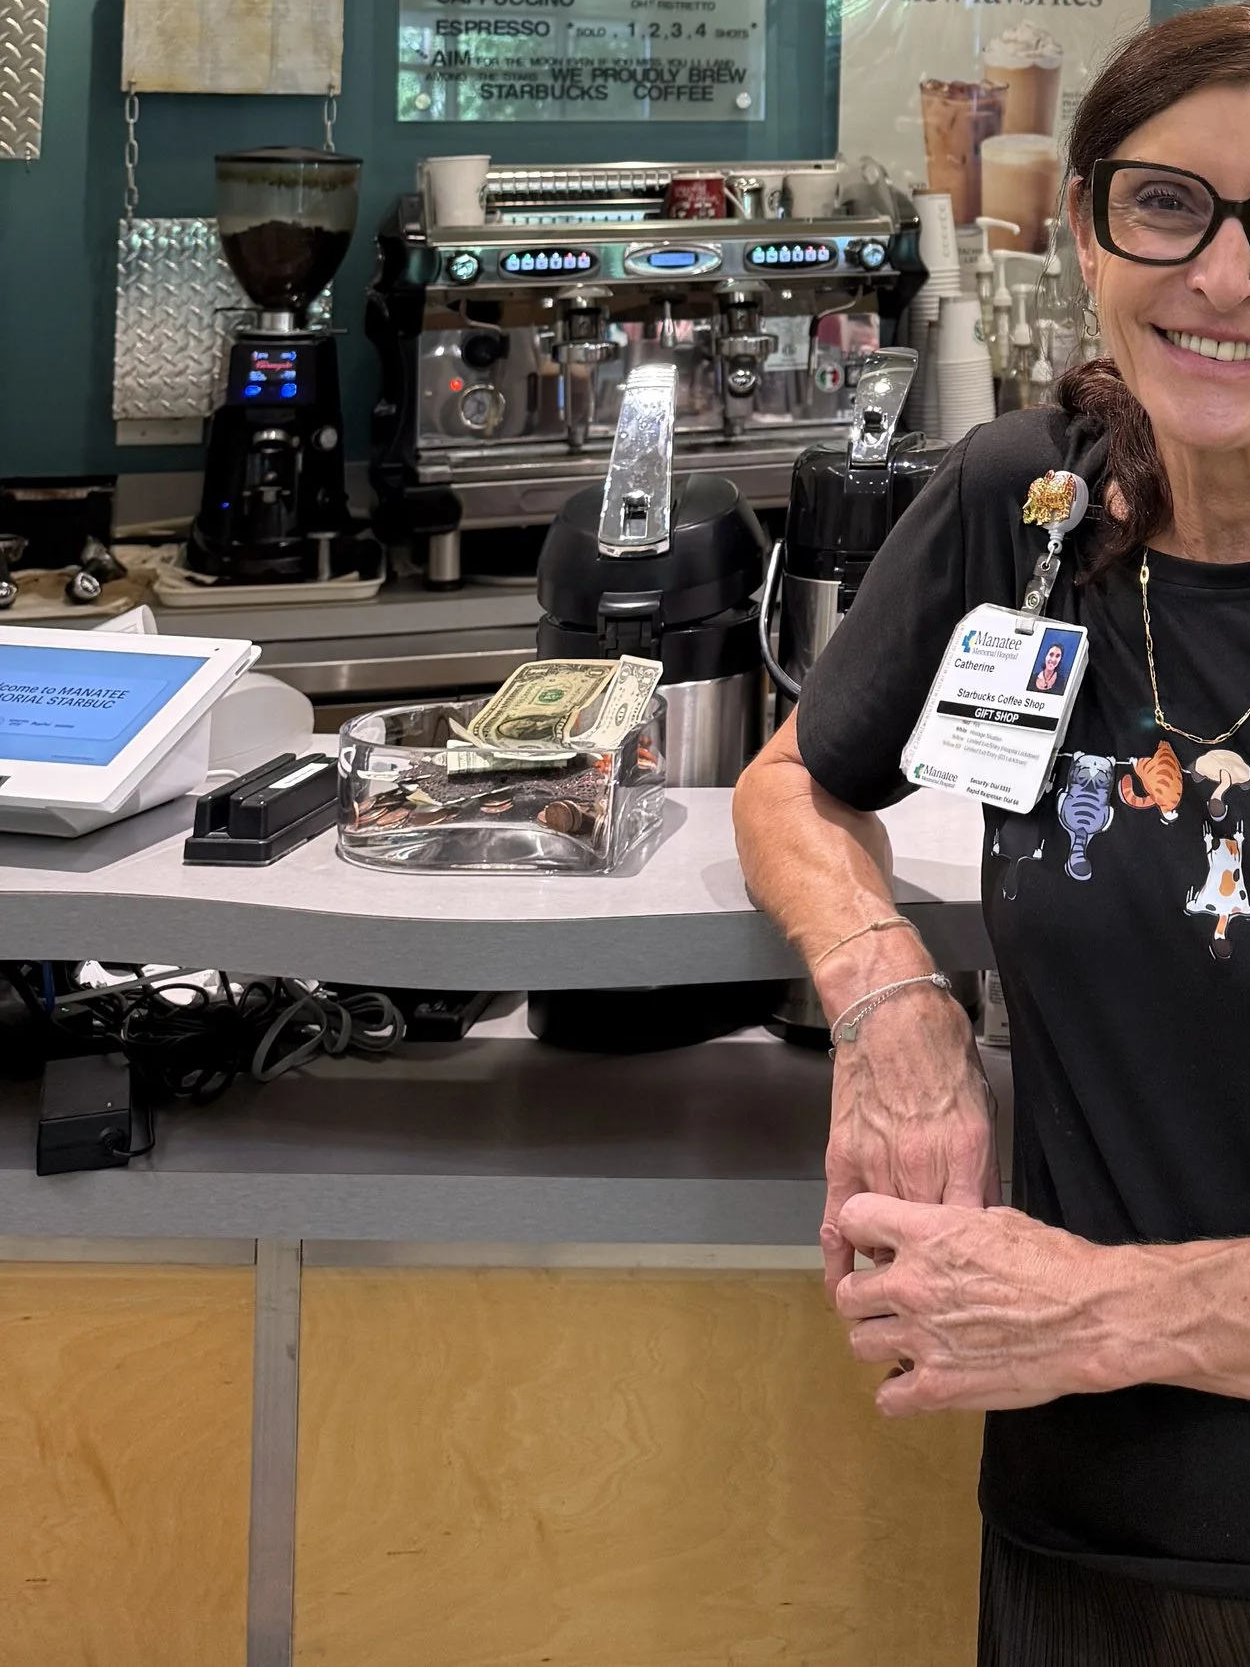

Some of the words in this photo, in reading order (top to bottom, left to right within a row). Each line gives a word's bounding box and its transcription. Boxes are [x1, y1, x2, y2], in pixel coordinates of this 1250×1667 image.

[435, 20, 550, 37] ESPRESSO
[432, 50, 471, 67] AIM
[551, 68, 582, 83] WE
[591, 68, 680, 84] PROUDLY
[689, 68, 747, 83] BREW
[480, 84, 608, 101] STARBUCKS
[633, 85, 714, 102] COFFEE
[974, 631, 1022, 651] Manatee
[972, 647, 997, 658] Memorial
[997, 650, 1019, 662] Hospital
[954, 658, 995, 673] Catherine
[0, 693, 43, 705] ORIAL
[46, 696, 116, 709] STARBUC
[41, 686, 57, 695] to
[58, 686, 130, 700] MANATEE
[957, 688, 996, 703] Starbucks
[997, 694, 1022, 707] Coffee
[1024, 698, 1045, 711] Shop
[974, 707, 995, 721] GIFT
[994, 711, 1019, 723] SHOP
[923, 764, 959, 783] Manatee
